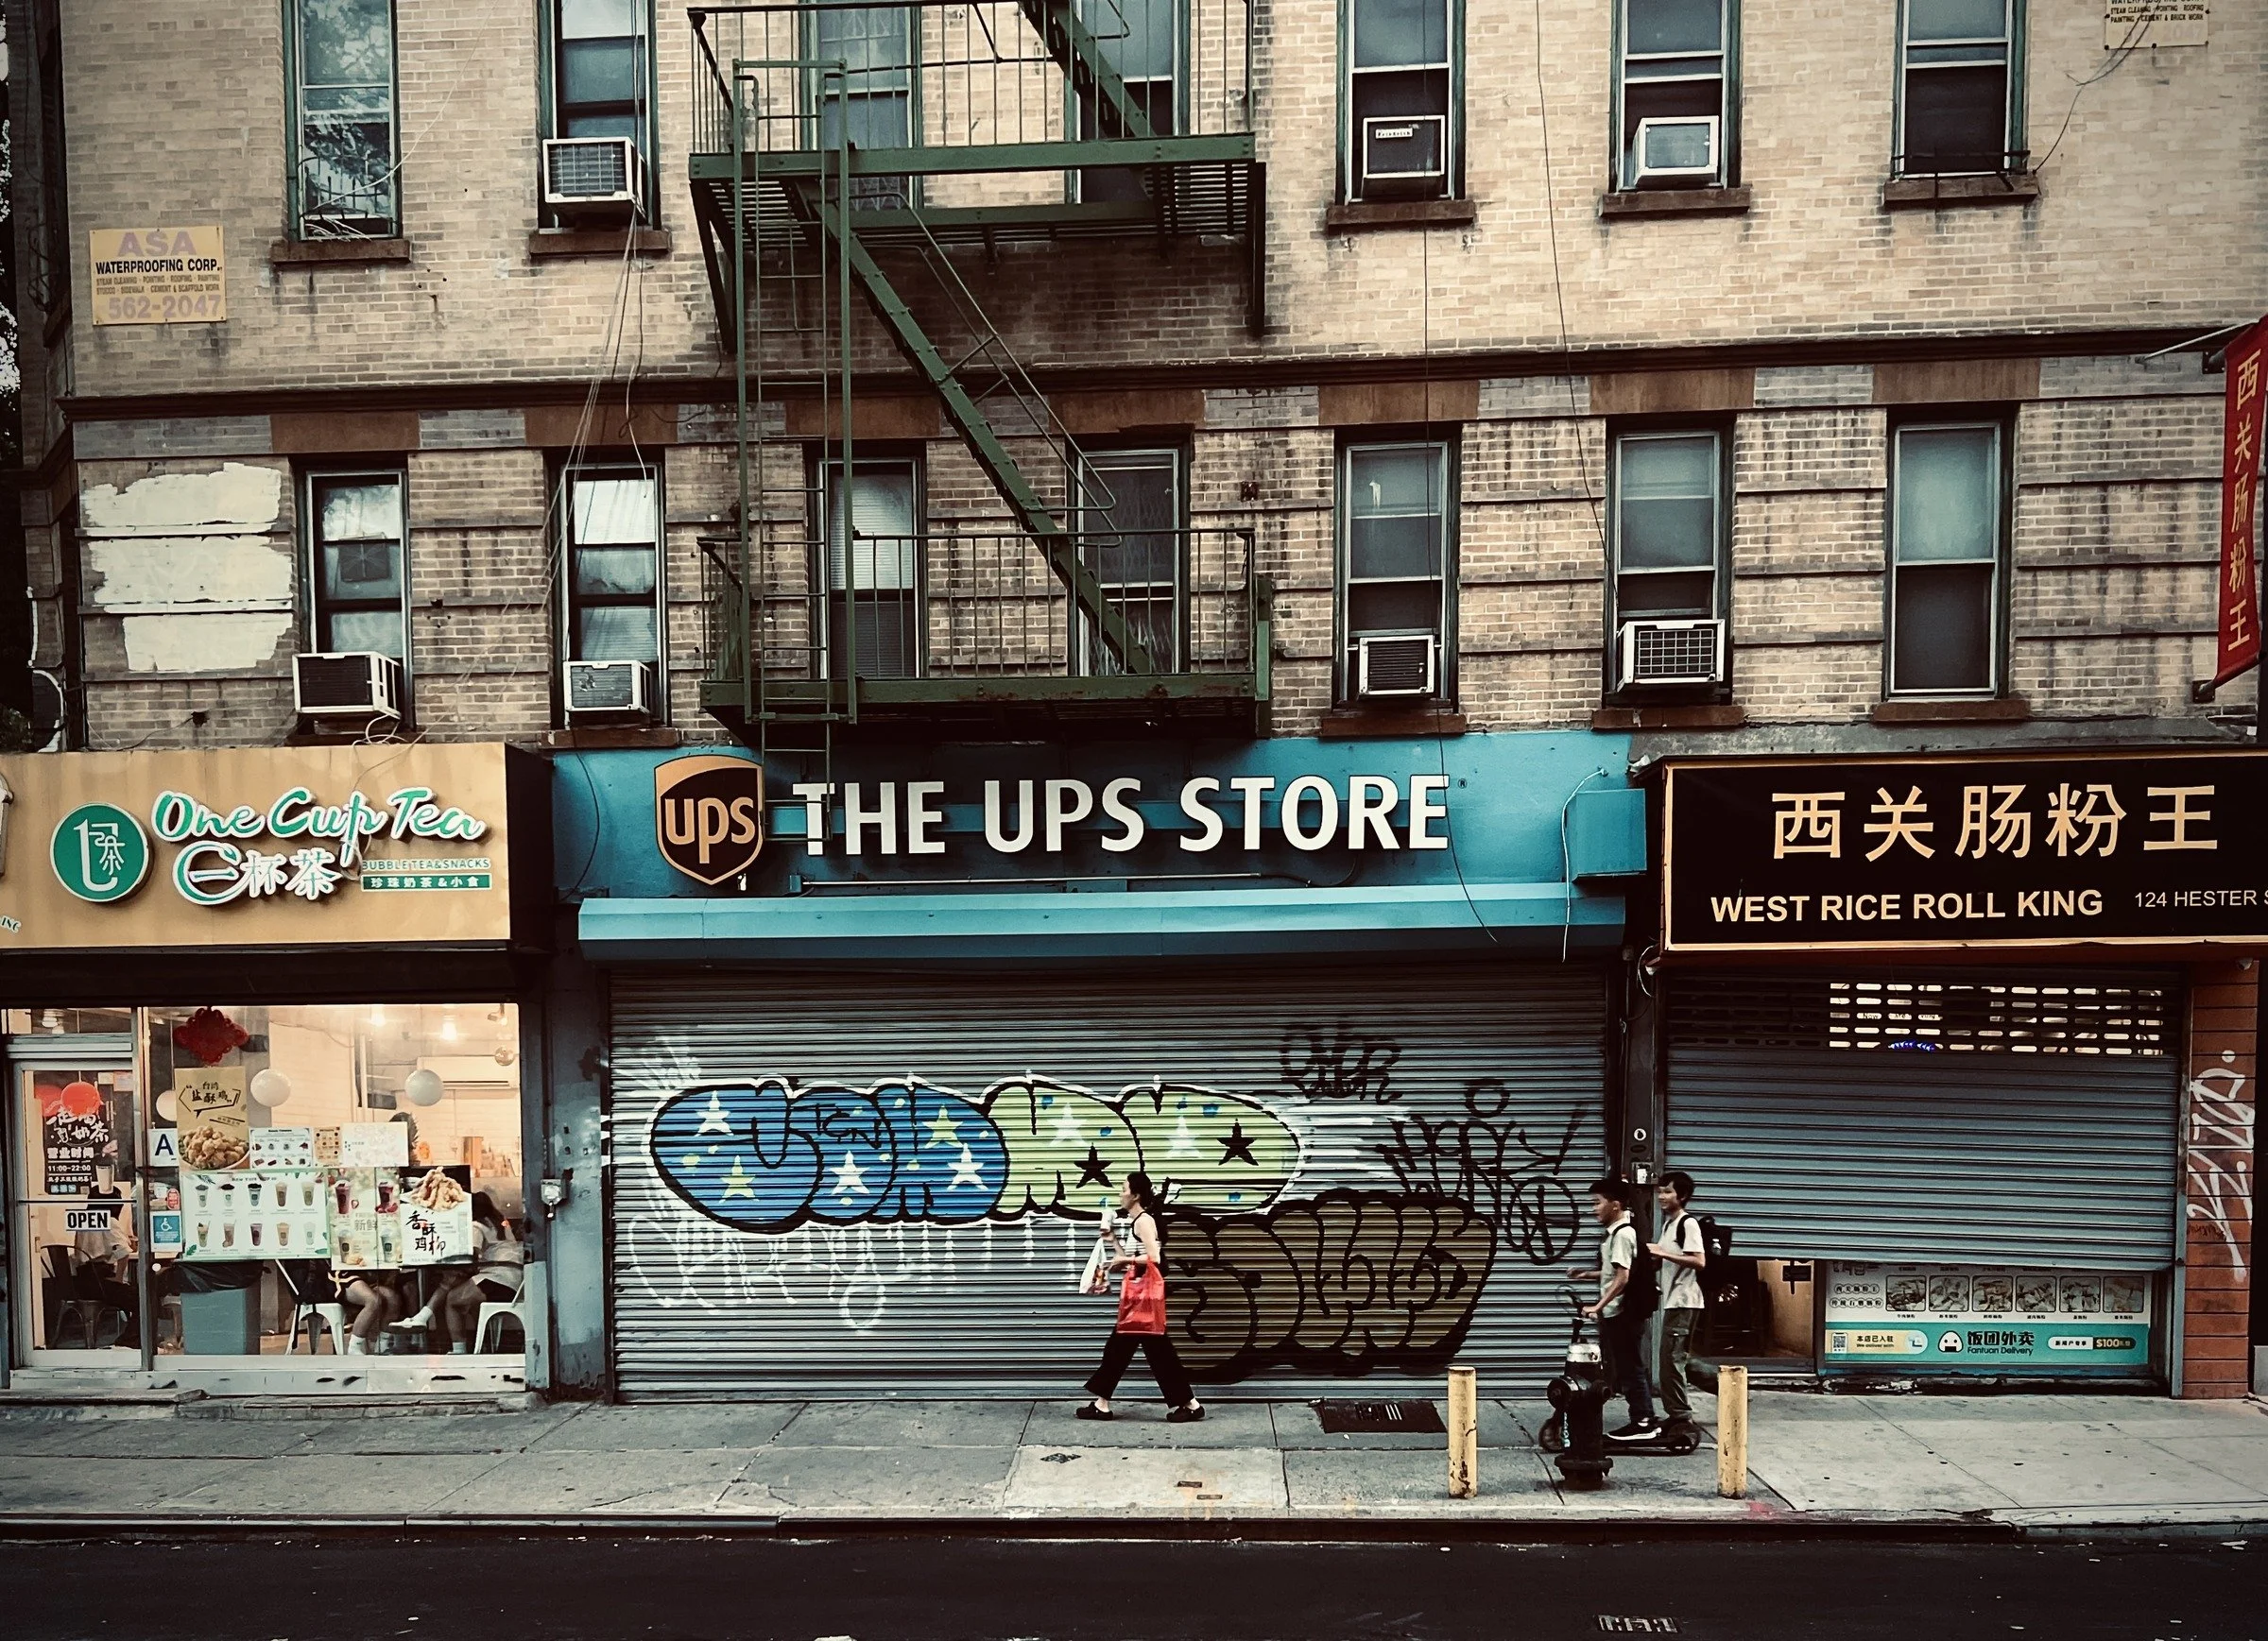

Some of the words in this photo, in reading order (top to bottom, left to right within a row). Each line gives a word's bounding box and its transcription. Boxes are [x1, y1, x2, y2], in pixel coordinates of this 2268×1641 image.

[117, 231, 198, 258] ASA
[95, 259, 184, 275] WATERPROOFING
[187, 258, 220, 272] CORP.
[96, 278, 112, 286] STEAM
[108, 295, 222, 320] 562-2047
[2226, 350, 2261, 652] 西关肠粉王
[792, 772, 946, 856] THE
[984, 778, 1143, 853] UPS
[1178, 774, 1450, 852] STORE
[1771, 782, 2220, 862] 西关肠粉王
[152, 790, 266, 843] One
[267, 786, 389, 867] Cup
[387, 786, 488, 841] Tea
[664, 795, 756, 864] ups
[172, 840, 343, 906] 一杯茶
[1710, 896, 1809, 923] WEST
[1820, 894, 1901, 921] RICE
[1913, 892, 2006, 920] ROLL
[2017, 889, 2104, 917] KING
[2135, 892, 2168, 908] 124
[2174, 890, 2258, 907] HESTER
[1, 916, 20, 932] INC
[47, 1147, 94, 1159] 营业时间
[154, 1134, 175, 1156] A
[67, 1212, 109, 1229] OPEN
[1967, 1330, 2035, 1346] 饭团外卖
[2001, 1346, 2034, 1357] Delivery
